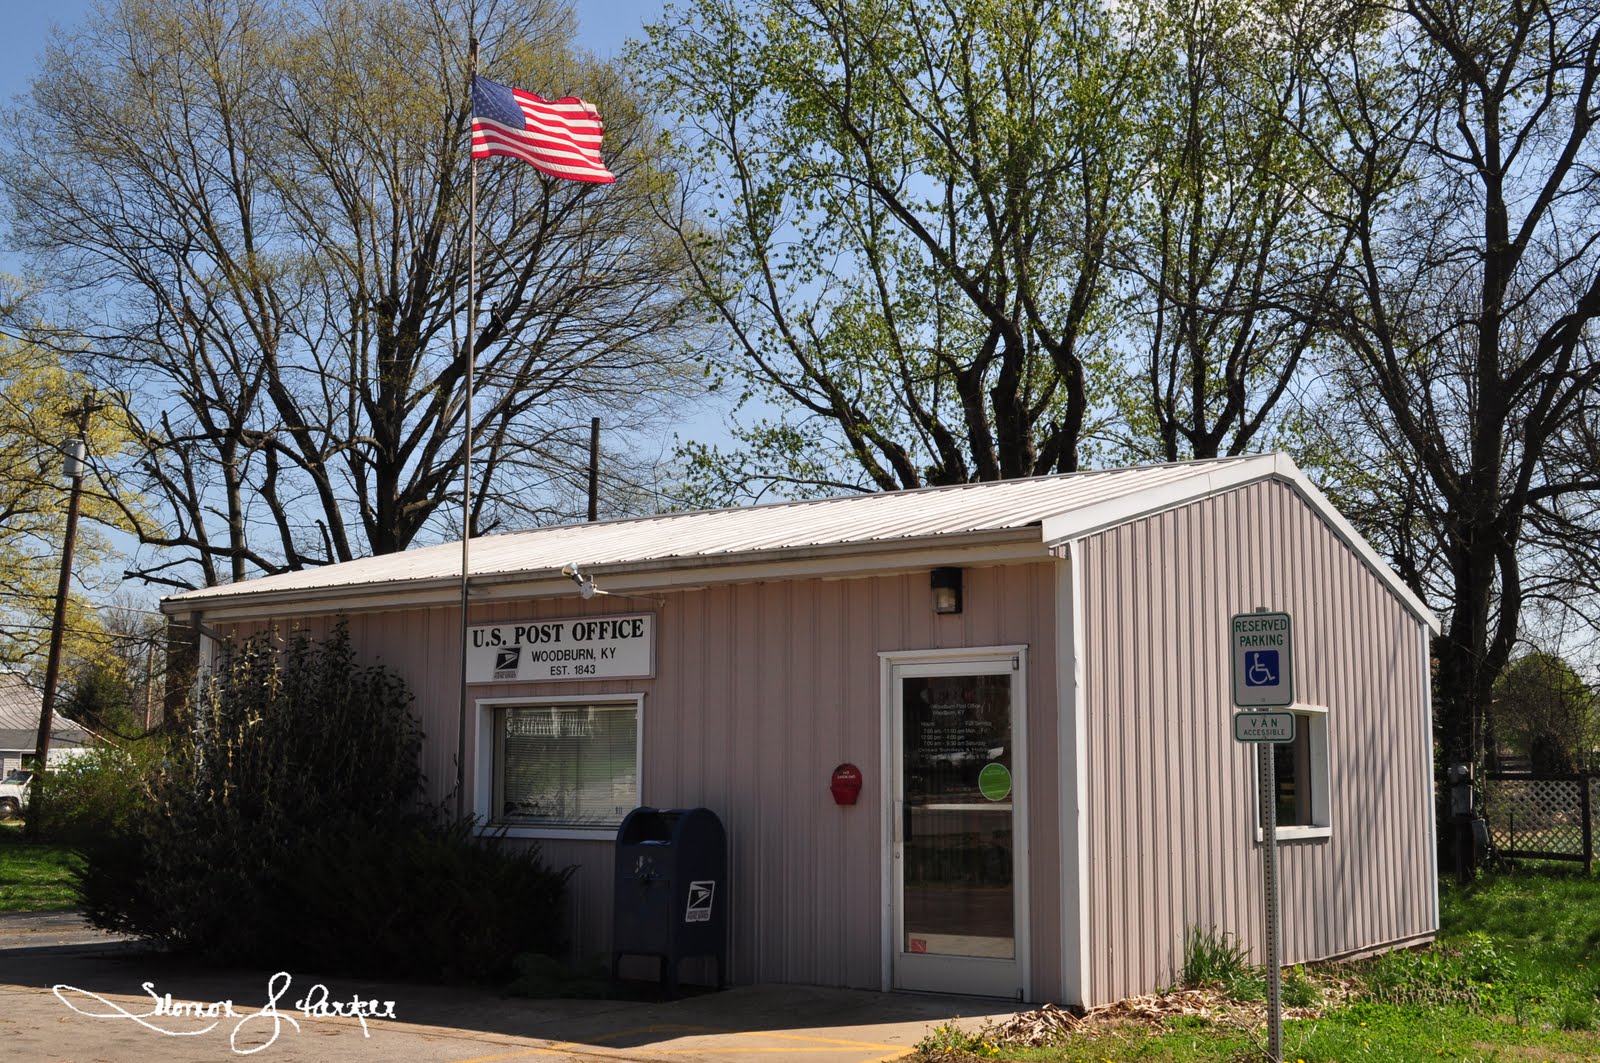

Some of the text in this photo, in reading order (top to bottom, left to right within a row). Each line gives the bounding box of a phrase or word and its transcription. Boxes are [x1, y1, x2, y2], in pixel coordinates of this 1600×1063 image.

[1235, 619, 1287, 632] RESERVED
[472, 618, 644, 648] U.S. POST OFFICE
[1240, 634, 1283, 647] PARKING
[532, 647, 616, 662] WOODBURN, KY
[550, 664, 596, 676] EST. 1843
[1250, 718, 1278, 728] VAN
[1243, 728, 1285, 736] ACCESSIBLE
